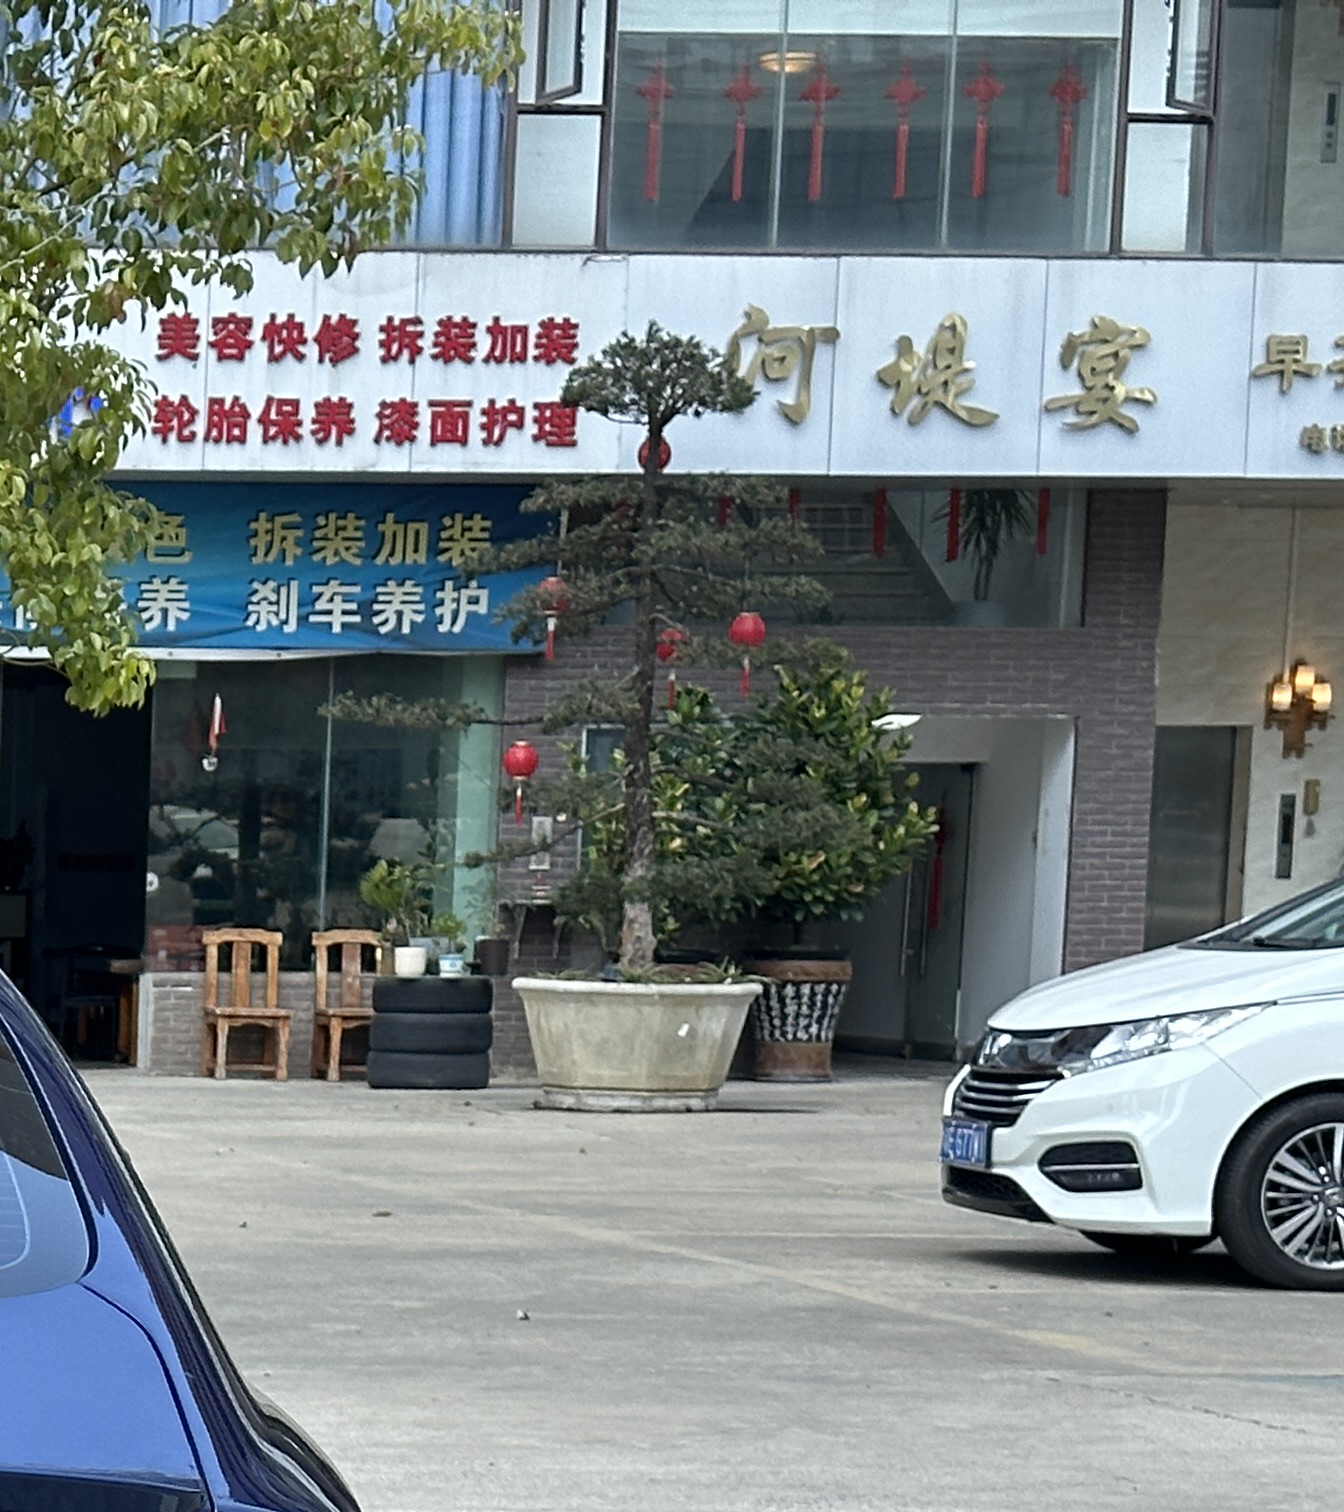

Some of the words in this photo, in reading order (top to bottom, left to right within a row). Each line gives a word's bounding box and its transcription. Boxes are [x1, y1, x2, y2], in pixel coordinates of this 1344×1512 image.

[155, 312, 362, 366] 美容快修
[379, 315, 581, 366] 拆装加装
[1251, 334, 1344, 394] 早
[152, 394, 357, 446] 轮胎保养
[374, 398, 579, 448] 漆面护理
[249, 511, 495, 567] 拆装加装
[248, 578, 490, 635] 刹车养护
